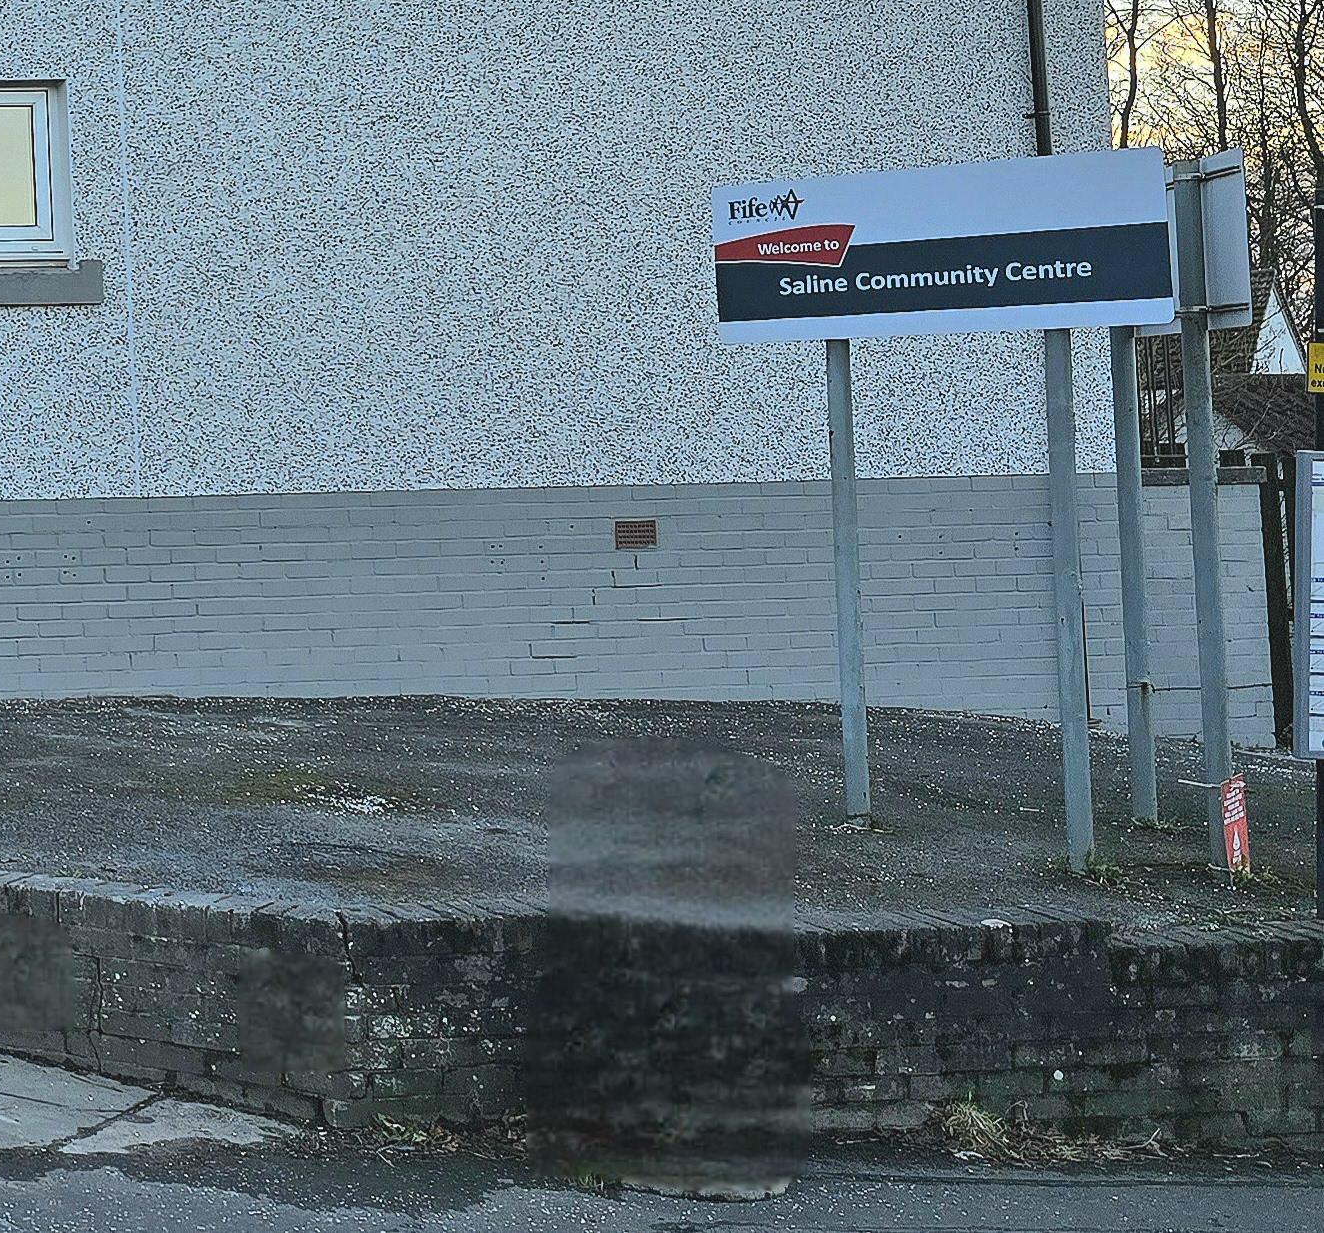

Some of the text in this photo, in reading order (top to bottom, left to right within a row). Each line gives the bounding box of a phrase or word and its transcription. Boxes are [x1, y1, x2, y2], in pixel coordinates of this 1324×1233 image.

[728, 197, 768, 220] Fife
[757, 239, 840, 255] Welcome to
[779, 260, 1092, 296] Saline Community Centre
